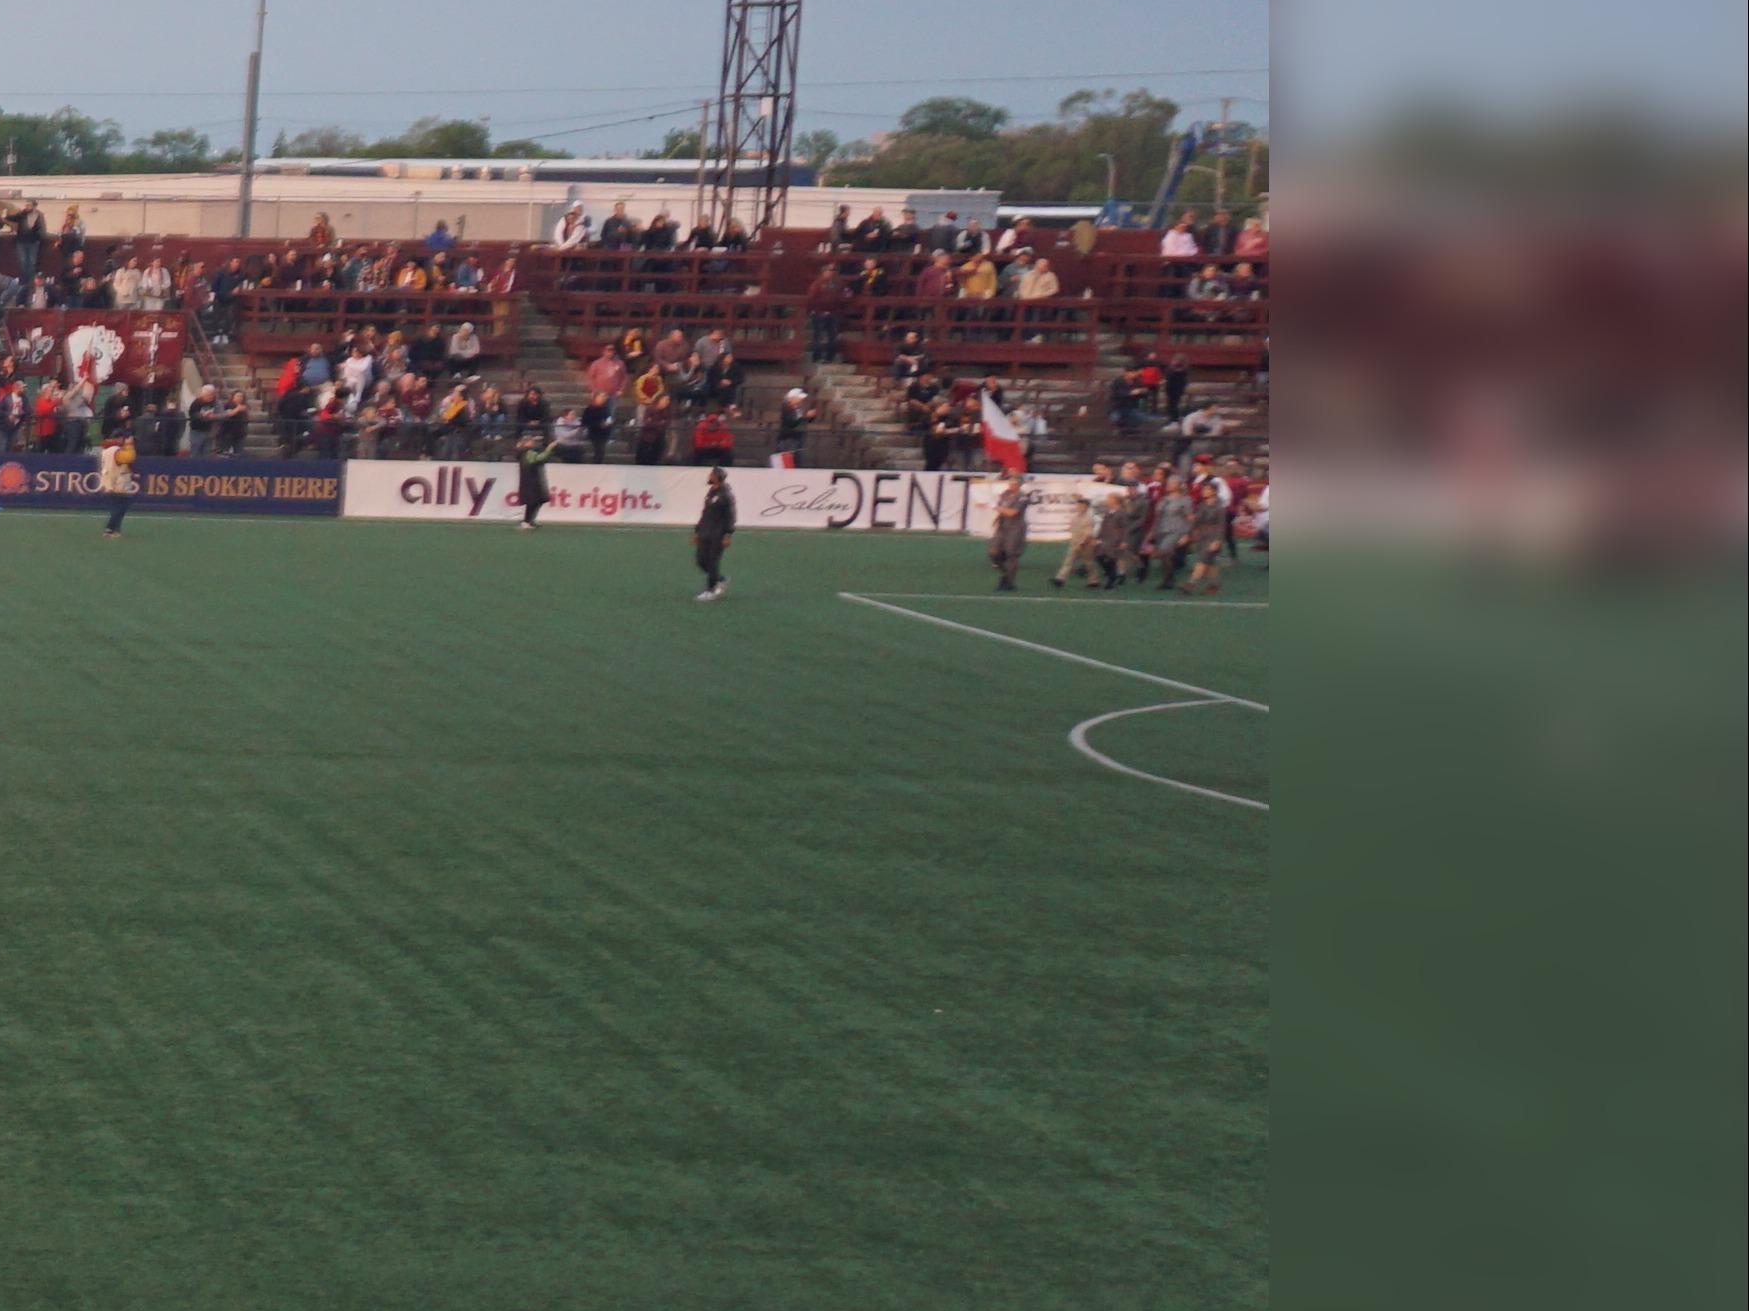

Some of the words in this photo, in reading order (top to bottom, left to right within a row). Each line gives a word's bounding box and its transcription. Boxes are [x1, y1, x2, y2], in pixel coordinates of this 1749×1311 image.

[147, 474, 168, 496] IS
[174, 475, 268, 498] SPOKEN
[273, 476, 337, 499] HERE
[400, 465, 498, 517] ally
[578, 487, 663, 517] right.
[760, 484, 852, 517] Salim
